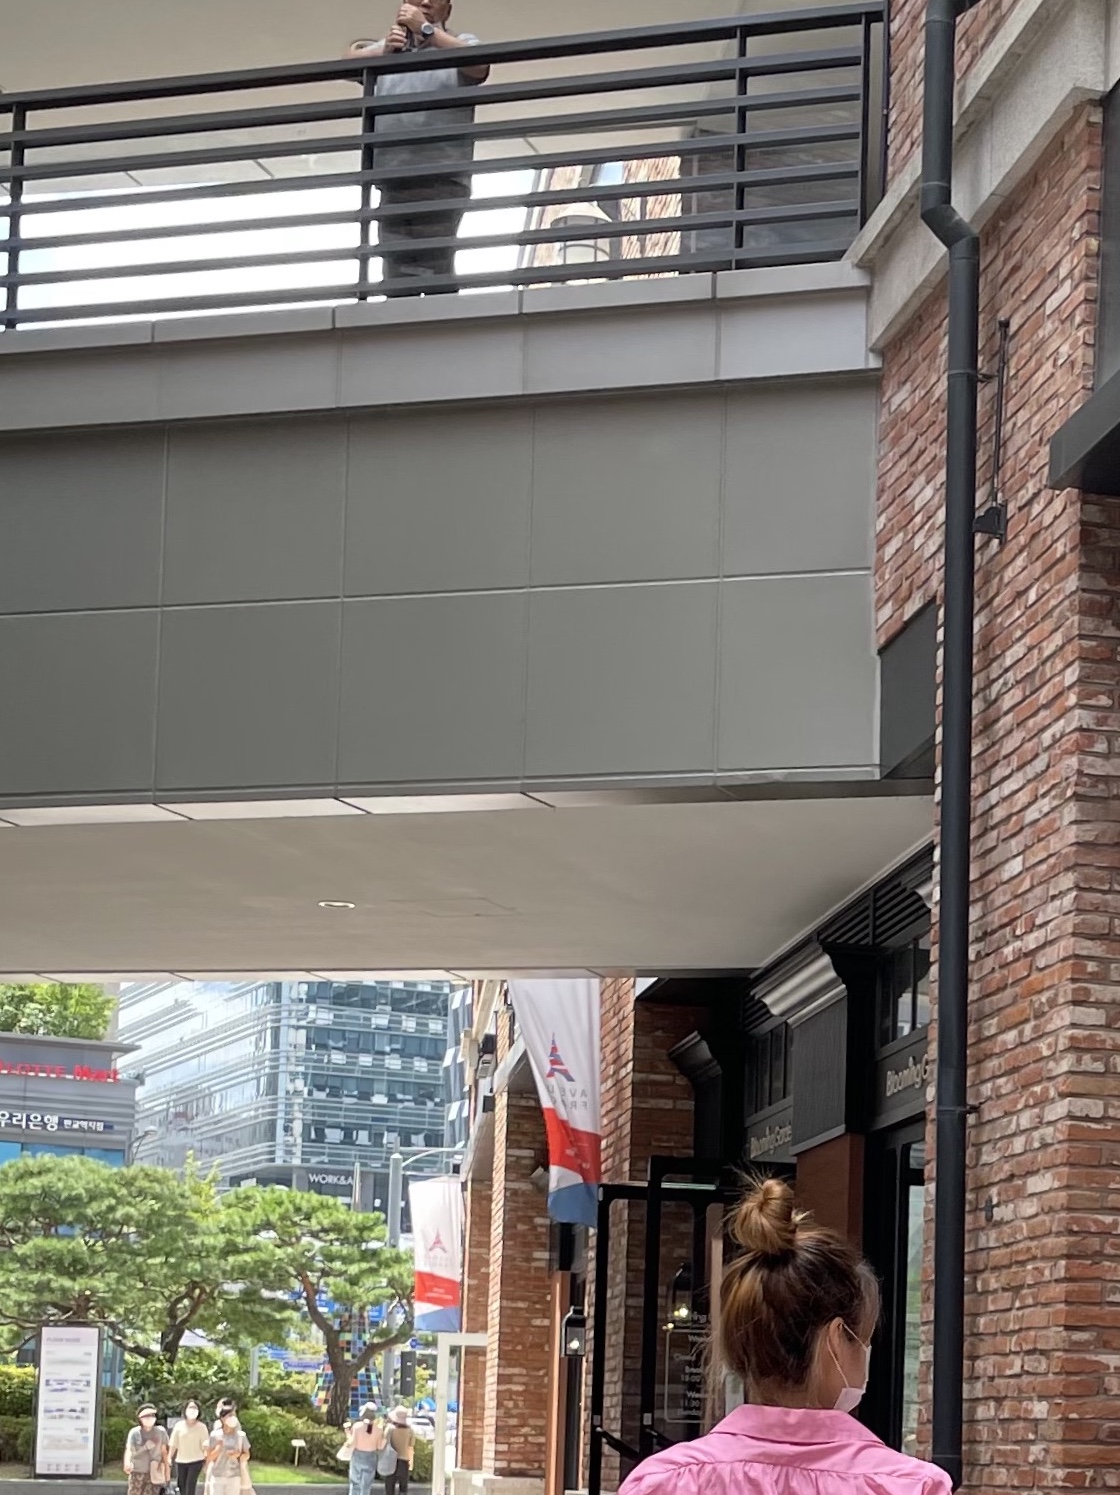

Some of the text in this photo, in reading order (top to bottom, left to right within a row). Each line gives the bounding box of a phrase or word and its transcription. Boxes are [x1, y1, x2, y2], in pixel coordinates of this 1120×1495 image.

[6, 1062, 119, 1083] LOTTE Mart
[886, 1056, 921, 1096] Blooming
[0, 1111, 59, 1132] 우리은행
